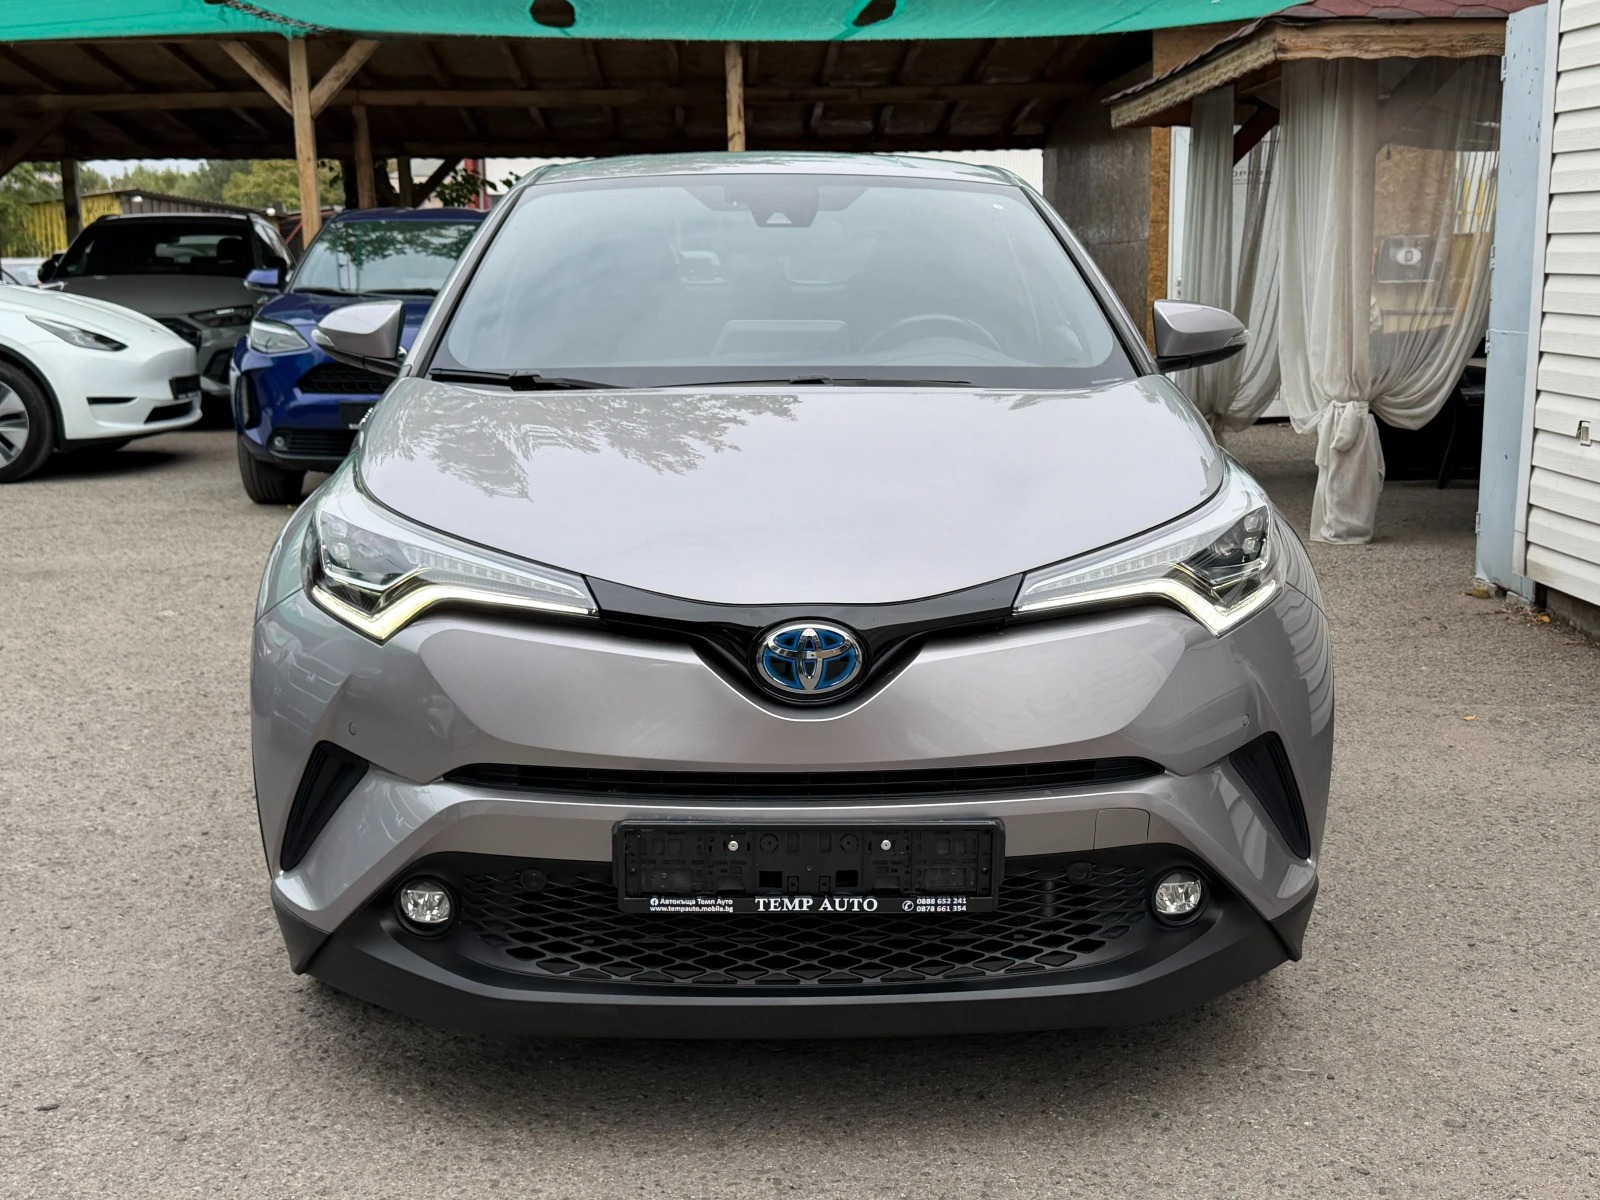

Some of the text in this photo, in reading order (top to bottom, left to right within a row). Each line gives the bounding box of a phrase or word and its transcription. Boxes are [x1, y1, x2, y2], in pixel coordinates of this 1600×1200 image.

[660, 898, 734, 906] Автокъща Темп Ауто
[754, 897, 878, 912] TEMP AUTO
[650, 905, 734, 913] www.tempauto.mobile.bg
